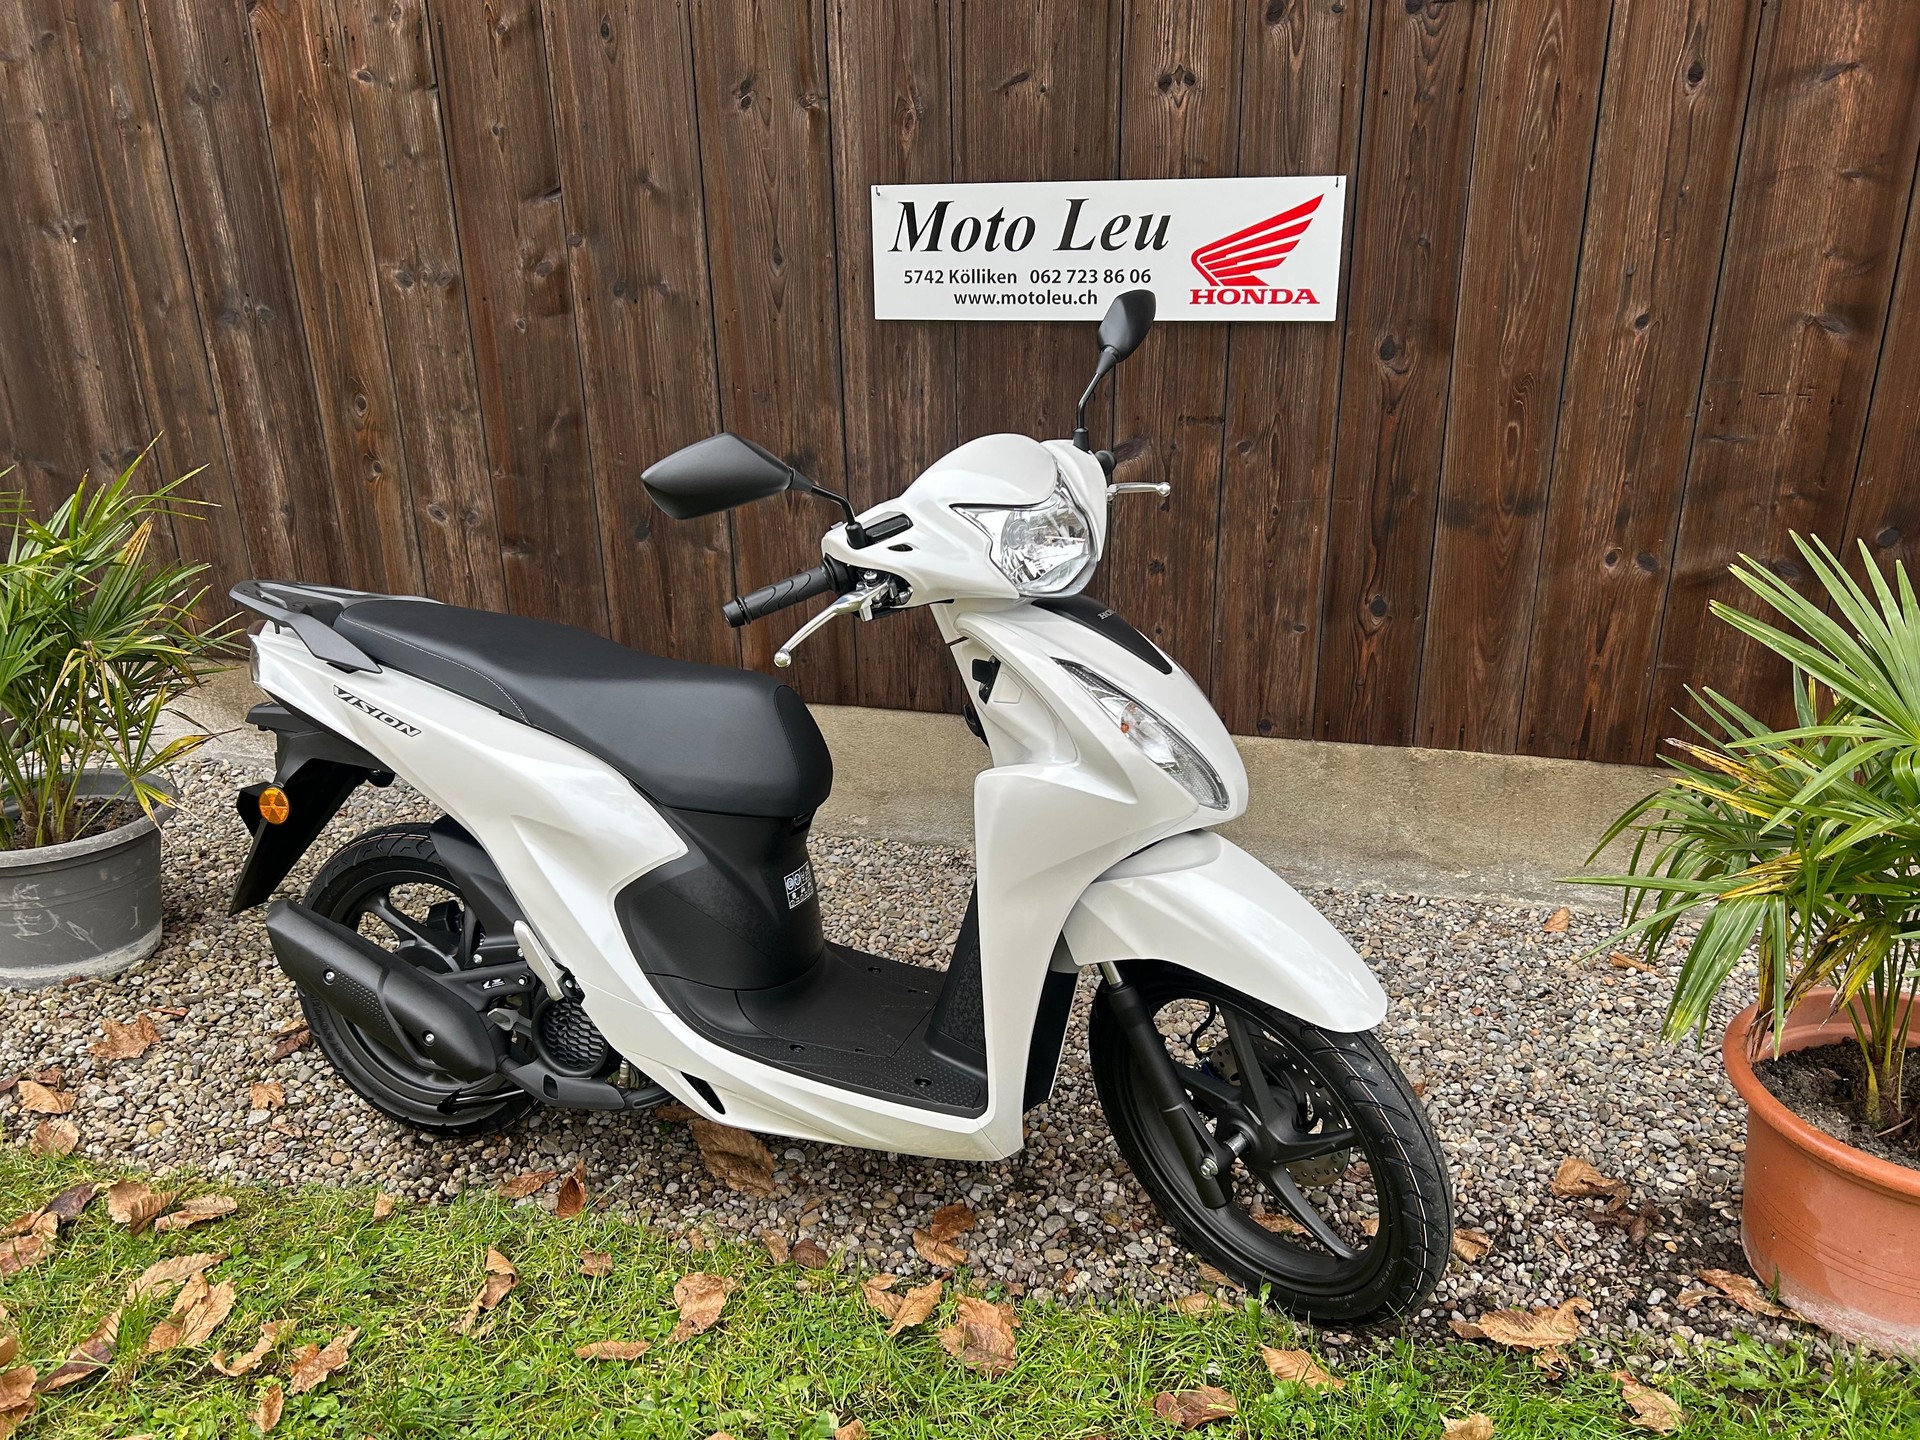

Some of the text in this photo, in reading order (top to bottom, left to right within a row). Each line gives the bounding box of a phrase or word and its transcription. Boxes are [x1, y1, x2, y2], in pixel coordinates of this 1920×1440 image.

[888, 197, 1172, 253] Moto Leu
[903, 267, 1152, 285] 5742 Kölliken 062 723 86 06
[953, 288, 1098, 306] www.motoleu.ch
[1189, 288, 1320, 305] HONDA
[333, 684, 422, 738] VISION
